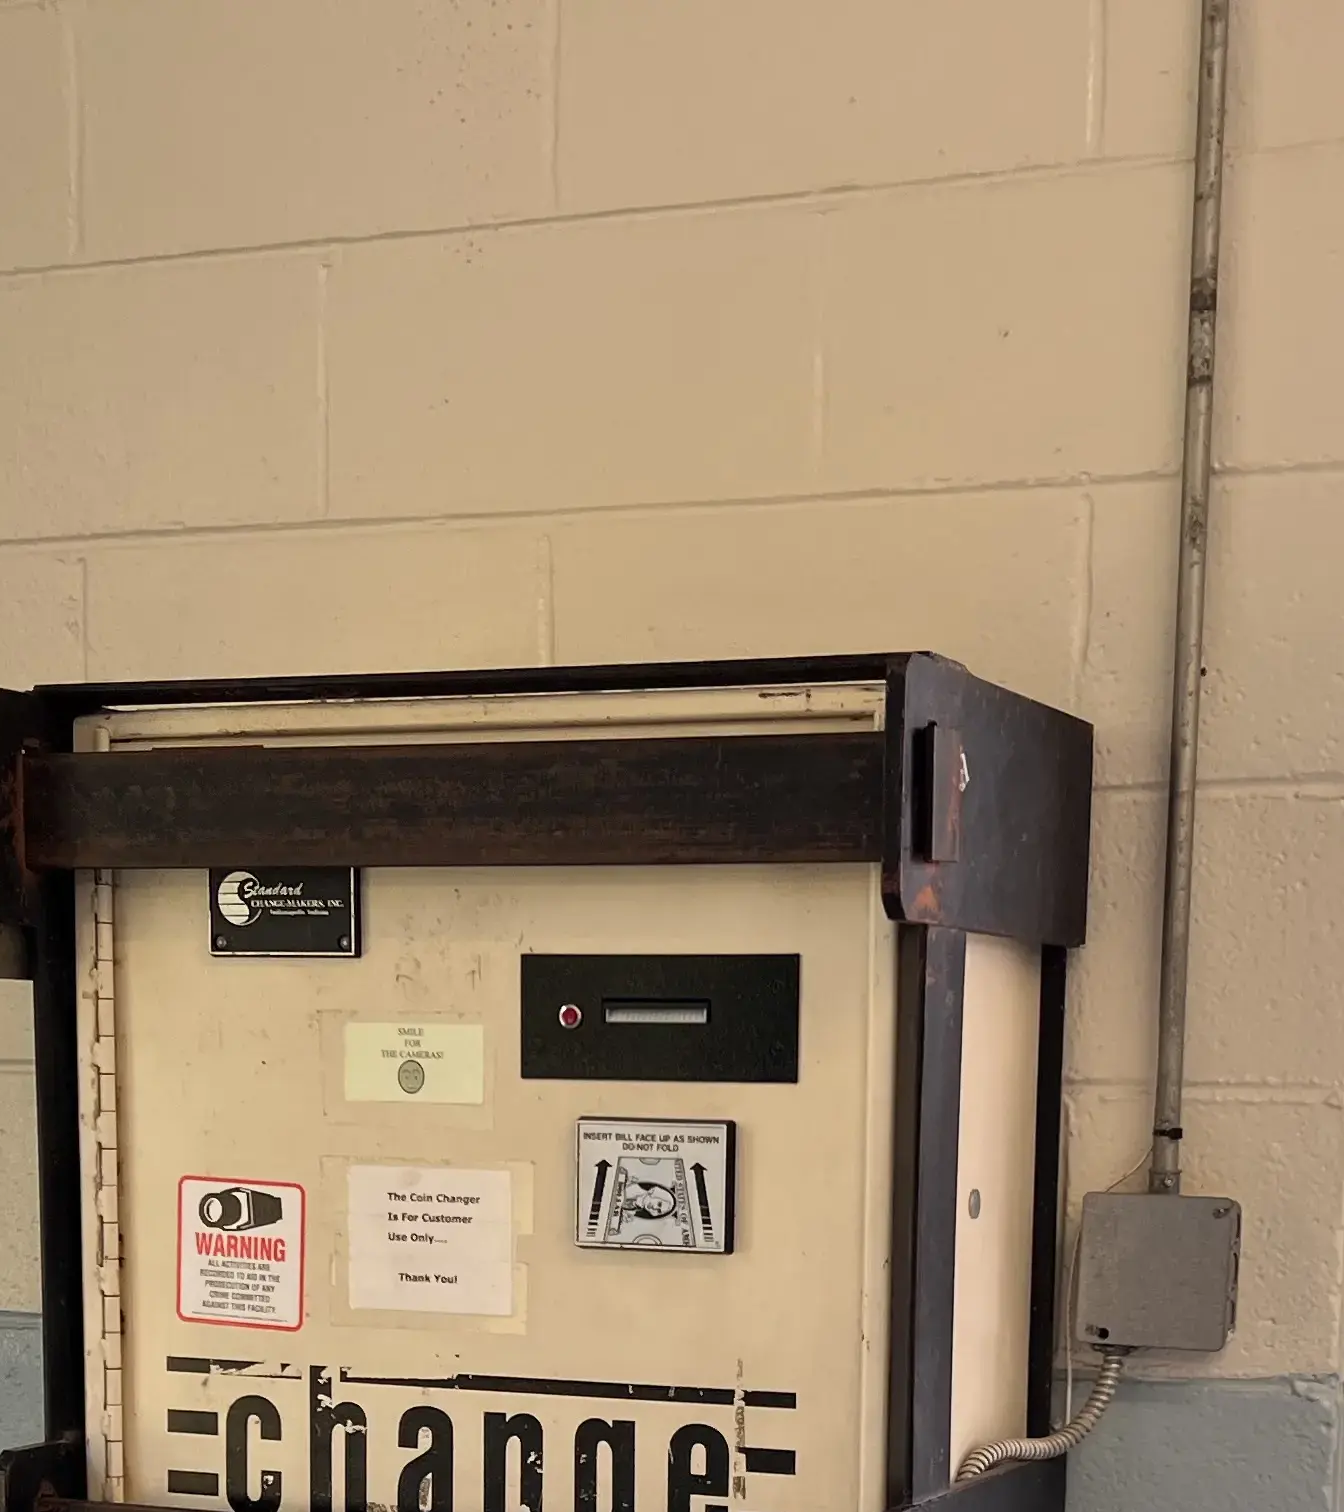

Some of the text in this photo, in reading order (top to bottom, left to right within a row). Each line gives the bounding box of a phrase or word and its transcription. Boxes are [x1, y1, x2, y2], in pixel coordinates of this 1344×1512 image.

[244, 881, 304, 898] Standard
[397, 1027, 424, 1036] SMILE
[404, 1039, 421, 1047] FOR
[381, 1049, 397, 1058] THE
[583, 1132, 719, 1144] INSERT BILL FACE UP AS SHOWN
[622, 1142, 679, 1152] DO NOT FOLD
[387, 1192, 480, 1205] The Coin Changer
[388, 1212, 473, 1224] Is For Customer
[388, 1232, 407, 1241] Use
[195, 1231, 286, 1262] WARNING
[208, 1259, 220, 1267] ALL
[398, 1272, 458, 1284] Thank You!
